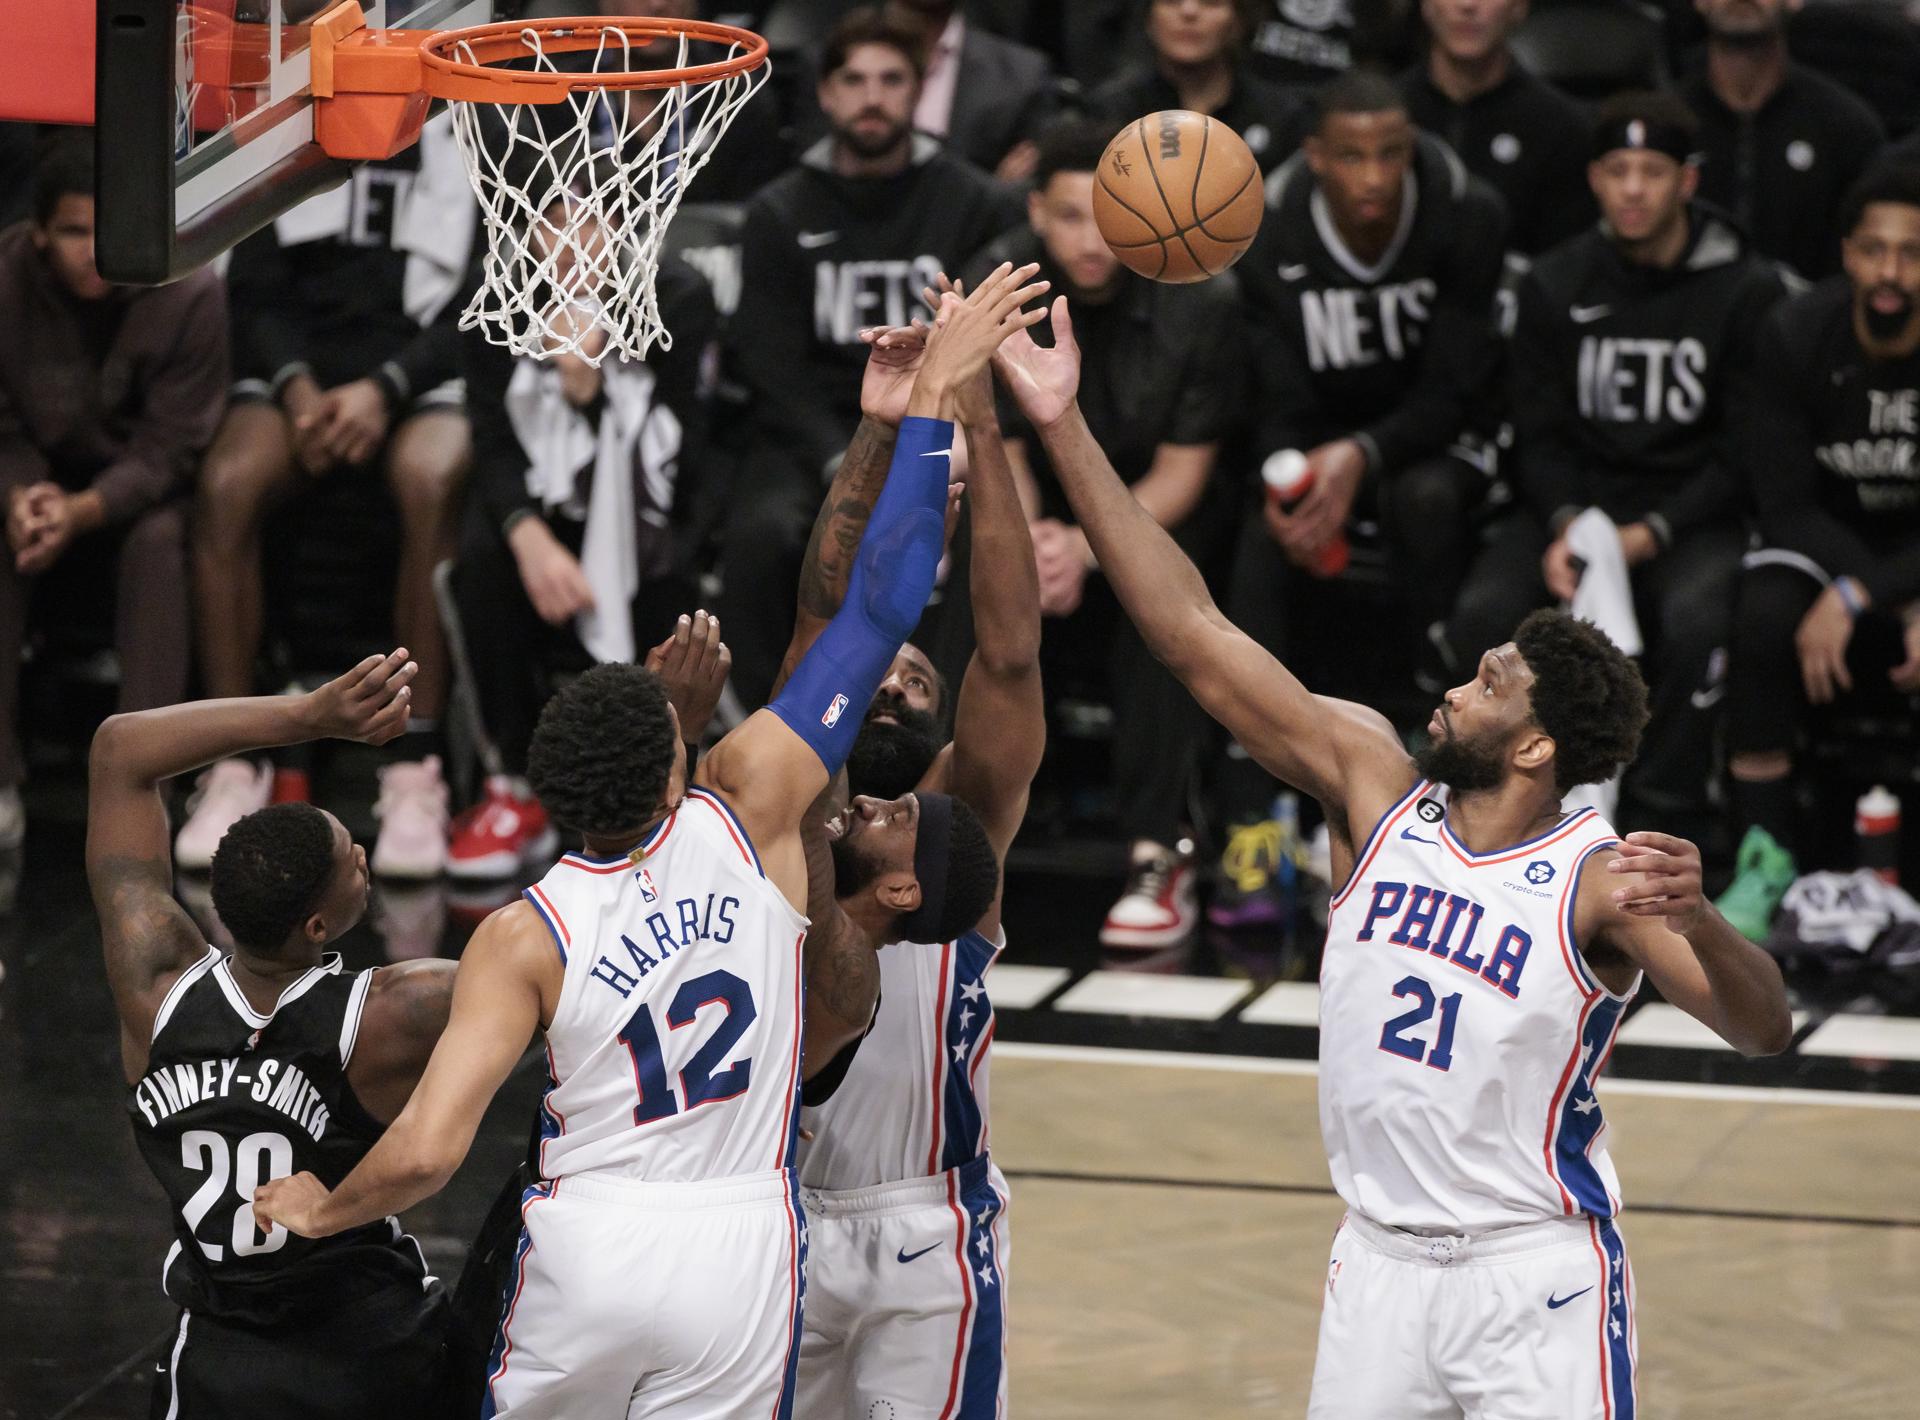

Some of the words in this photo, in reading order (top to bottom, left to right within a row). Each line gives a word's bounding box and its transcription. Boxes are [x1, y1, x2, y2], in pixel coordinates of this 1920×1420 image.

[1577, 335, 1707, 424] NETS
[1419, 801, 1441, 822] 6
[1503, 881, 1553, 899] crypto.com
[590, 893, 740, 999] HARRIS
[1356, 880, 1533, 1000] PHILA
[616, 968, 758, 1127] 12
[1378, 975, 1464, 1072] 21
[136, 1057, 331, 1143] FINNEY-SMITH
[181, 1129, 293, 1262] 28
